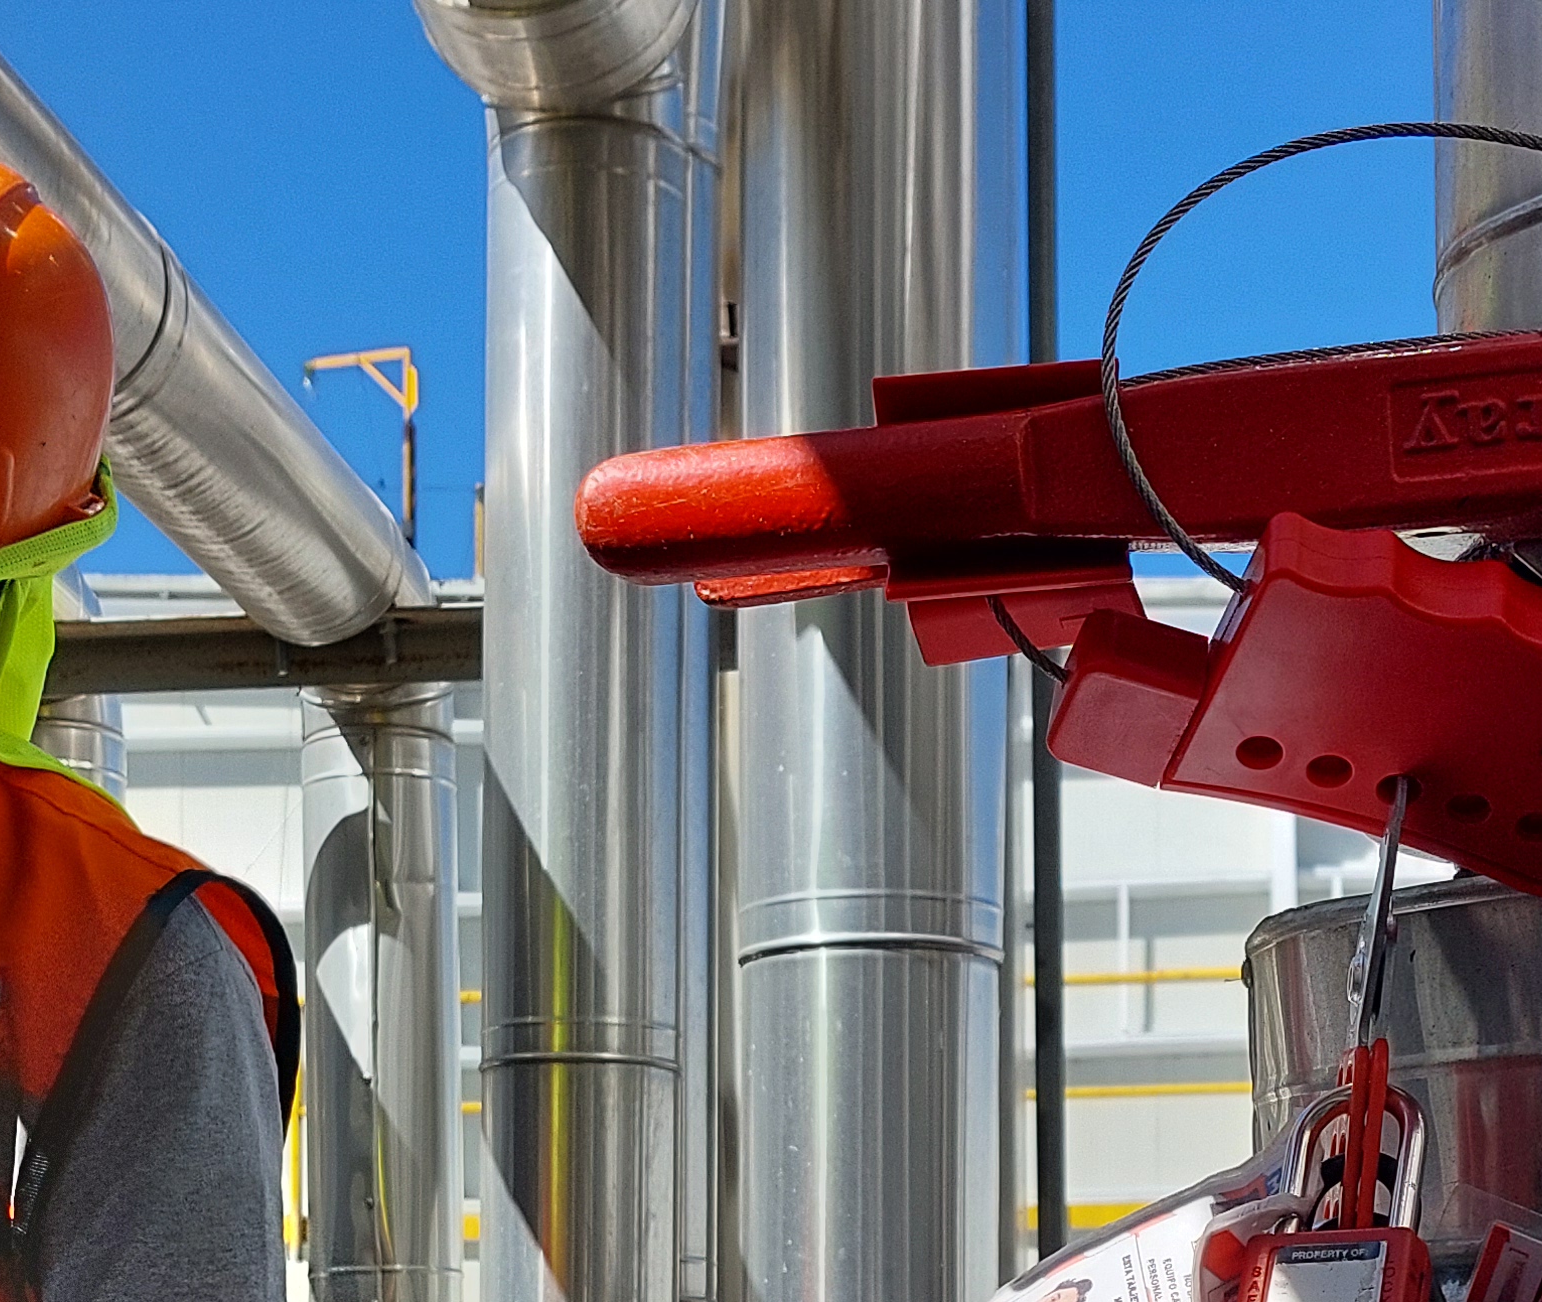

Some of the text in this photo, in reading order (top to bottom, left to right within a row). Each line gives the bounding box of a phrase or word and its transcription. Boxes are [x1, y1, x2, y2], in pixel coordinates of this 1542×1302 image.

[1121, 1254, 1133, 1276] ESTA
[1291, 1248, 1348, 1260] PROPERTY
[1146, 1258, 1163, 1302] PERSONAL
[1162, 1258, 1177, 1290] EQUIPO
